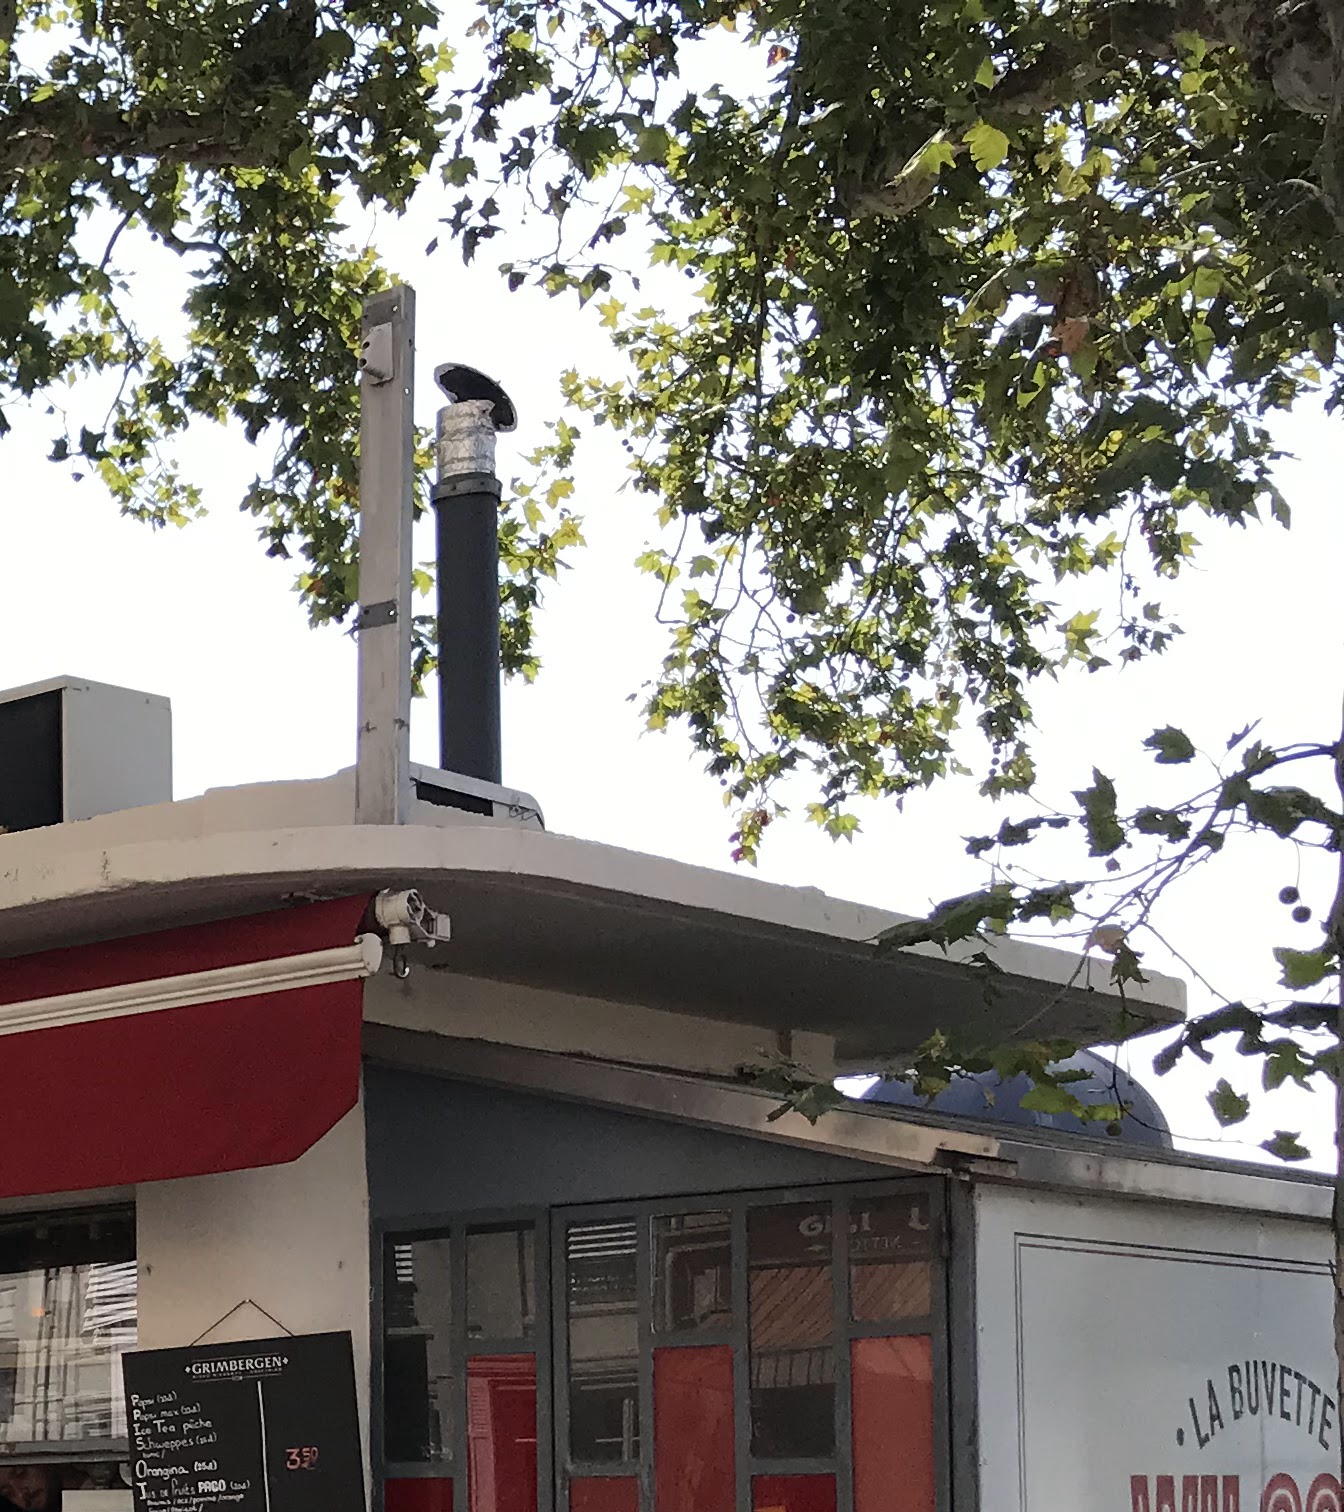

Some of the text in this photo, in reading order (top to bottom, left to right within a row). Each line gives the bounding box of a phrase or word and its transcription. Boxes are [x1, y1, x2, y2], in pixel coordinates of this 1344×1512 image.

[192, 1356, 282, 1374] GRIMBERGEN
[1188, 1360, 1336, 1450] LA BUVETTE
[153, 1419, 175, 1433] Tea
[135, 1436, 193, 1451] Schweppes
[135, 1460, 189, 1480] Orangina
[198, 1479, 226, 1493] PAGO
